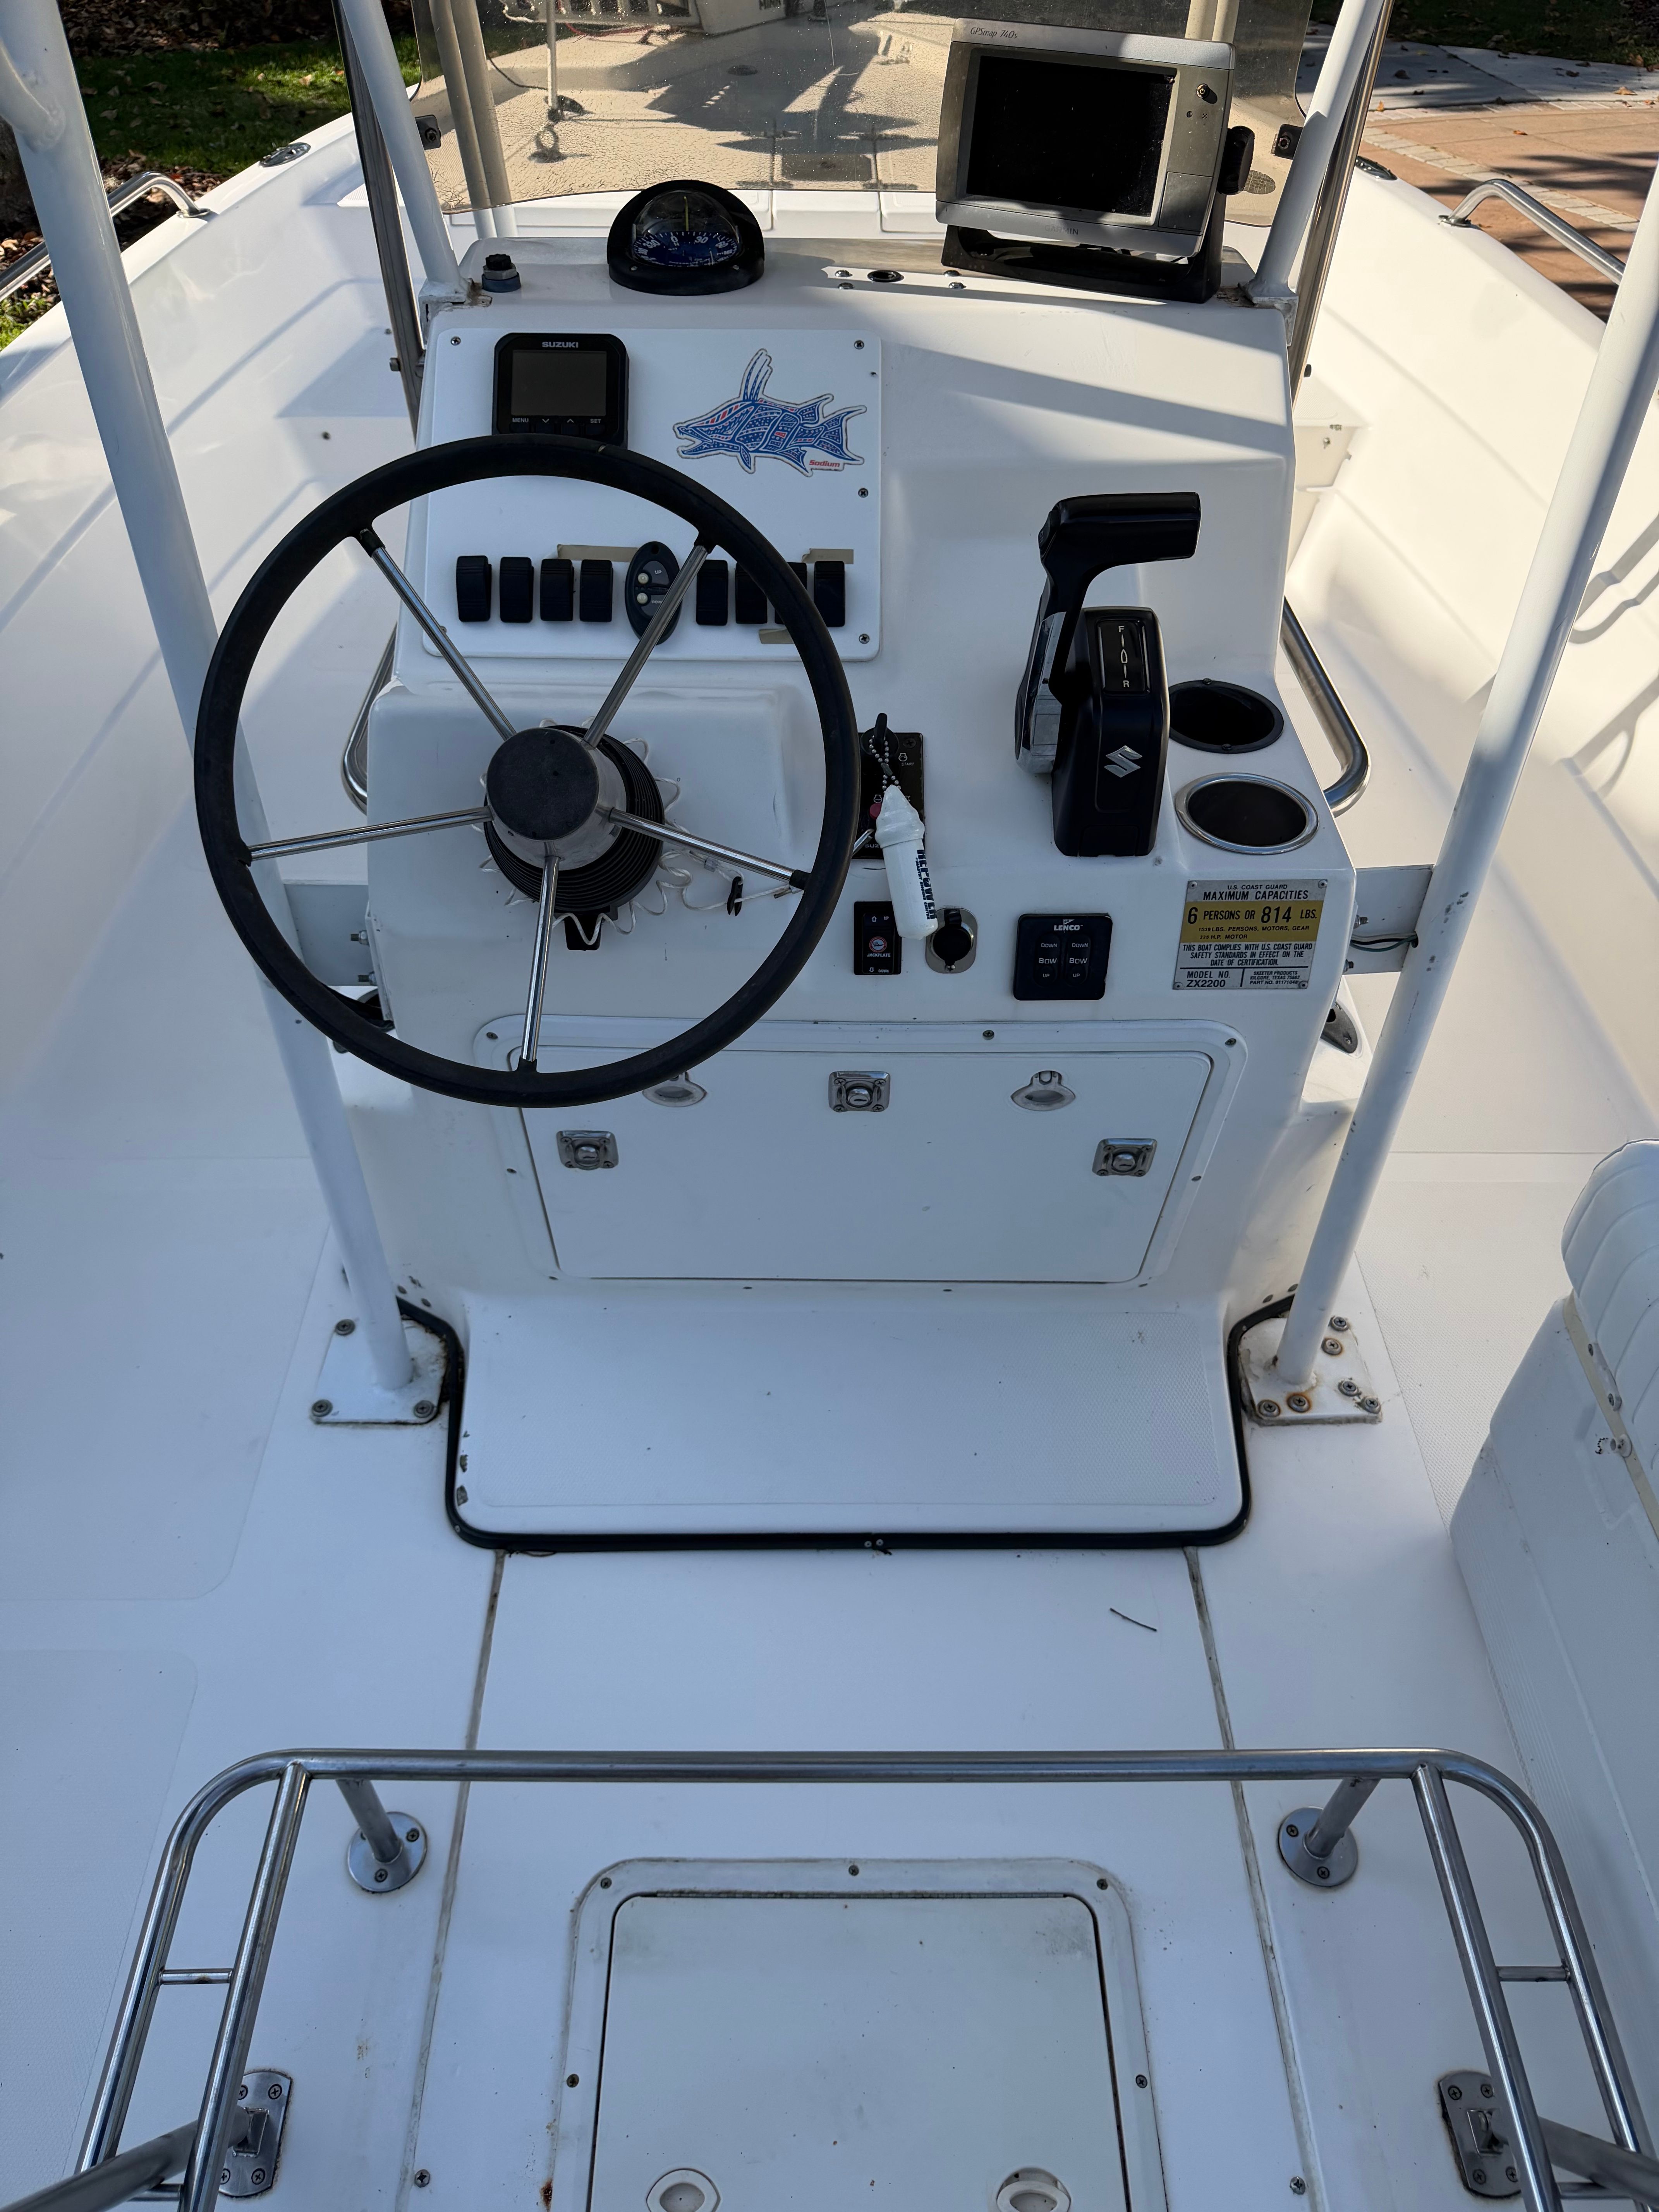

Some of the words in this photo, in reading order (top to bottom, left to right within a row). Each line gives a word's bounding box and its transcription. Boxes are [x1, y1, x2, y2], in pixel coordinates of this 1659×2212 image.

[970, 27, 997, 38] GPSmap
[1000, 30, 1018, 39] 740s
[809, 459, 840, 467] Sodium
[1203, 891, 1249, 900] MAXIMUM
[1255, 890, 1309, 900] CAPACITIES
[1188, 907, 1198, 924] 6
[1203, 910, 1240, 920] PERSONS
[1245, 910, 1255, 919] OR
[1261, 906, 1292, 923] 814
[1300, 909, 1317, 919] LBS.
